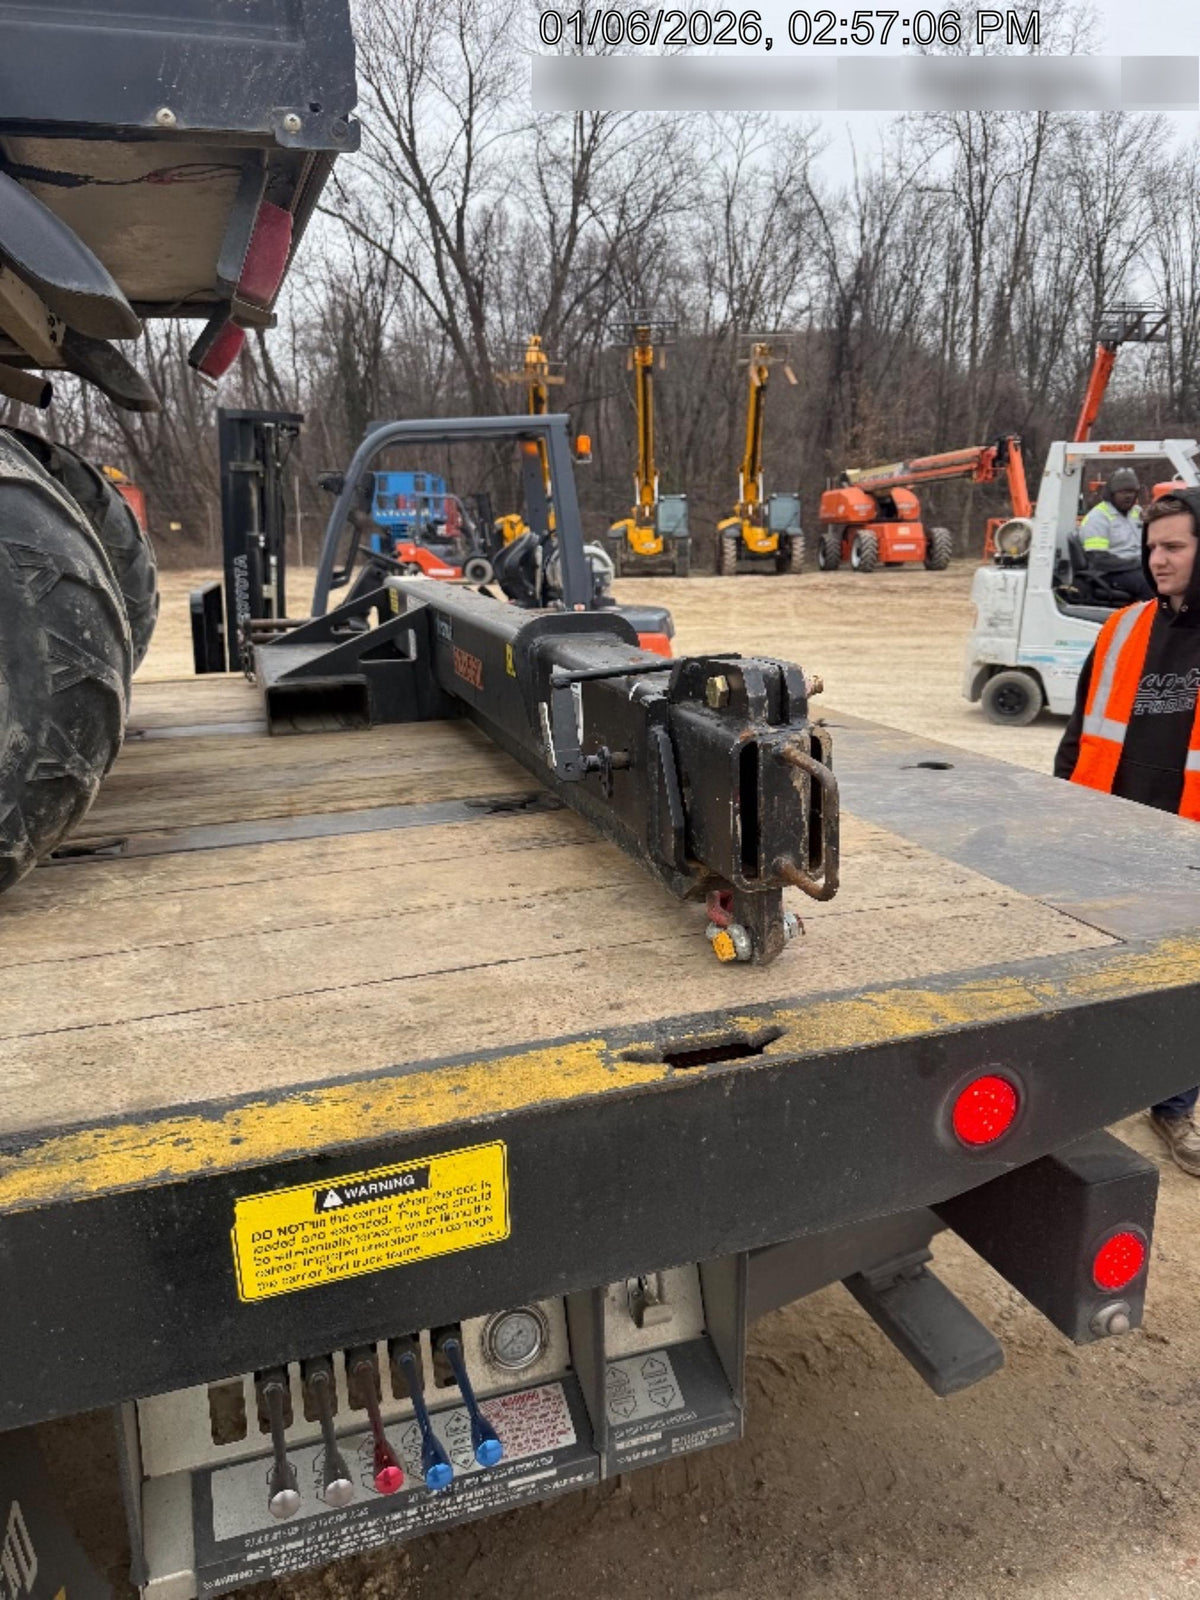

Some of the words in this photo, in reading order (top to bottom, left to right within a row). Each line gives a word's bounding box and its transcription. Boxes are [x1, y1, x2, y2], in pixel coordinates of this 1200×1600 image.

[343, 1174, 415, 1199] WARNING
[252, 1230, 273, 1243] DO
[277, 1221, 306, 1237] NOT
[330, 1213, 350, 1225] the
[481, 1180, 492, 1190] is
